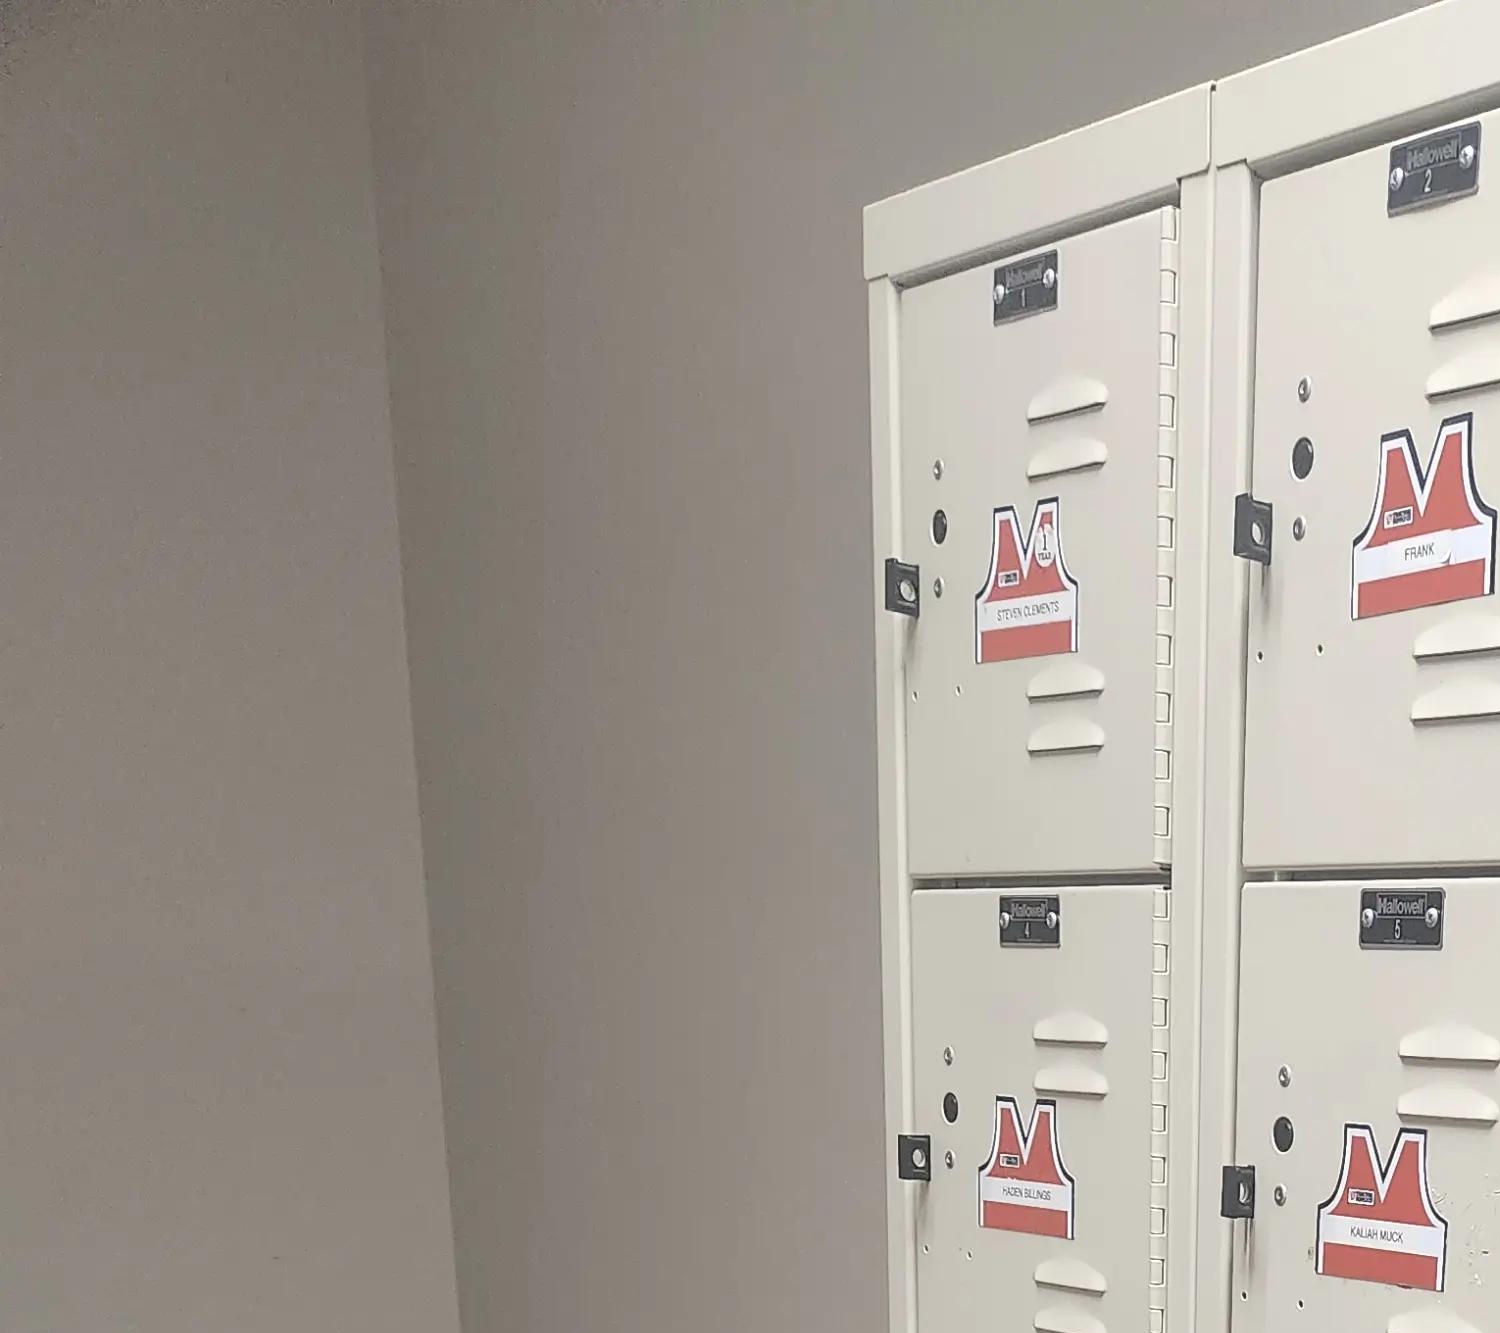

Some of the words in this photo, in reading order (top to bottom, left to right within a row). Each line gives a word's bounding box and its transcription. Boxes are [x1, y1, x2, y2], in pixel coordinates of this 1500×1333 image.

[1406, 143, 1456, 170] Hallowell
[1424, 169, 1433, 192] 2
[1020, 288, 1026, 307] 1
[1042, 534, 1047, 551] 1
[1404, 542, 1435, 561] FRANK
[996, 608, 1024, 622] STEVEN
[1024, 600, 1060, 618] CLEMENTS
[1011, 904, 1046, 918] Hallowell
[1378, 897, 1424, 914] Hallowell
[1024, 921, 1030, 939] 4
[1394, 919, 1401, 939] 5
[1350, 1225, 1378, 1240] KALIAH
[1380, 1230, 1404, 1244] MUCK
